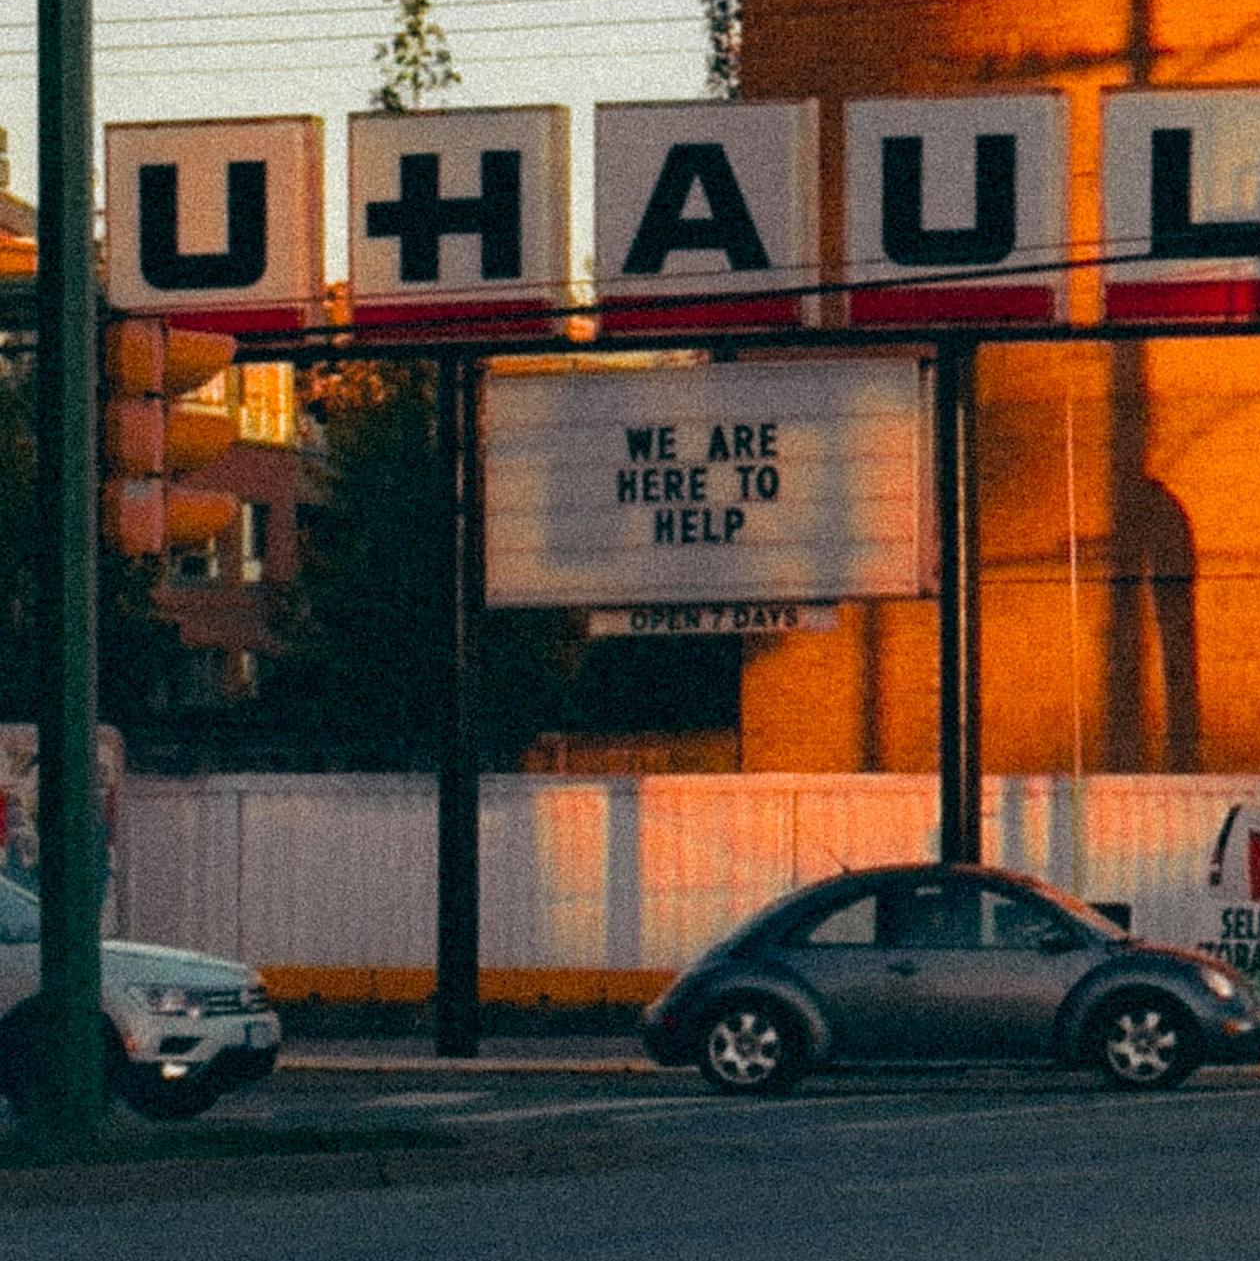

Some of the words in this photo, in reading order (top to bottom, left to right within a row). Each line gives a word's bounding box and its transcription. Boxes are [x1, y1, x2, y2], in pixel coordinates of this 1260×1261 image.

[625, 425, 677, 463] WE
[708, 423, 779, 462] ARE
[617, 468, 709, 503] HERE
[736, 465, 780, 500] TO
[654, 507, 745, 544] HELP
[630, 607, 701, 631] OPEN
[733, 605, 799, 629] DAYS
